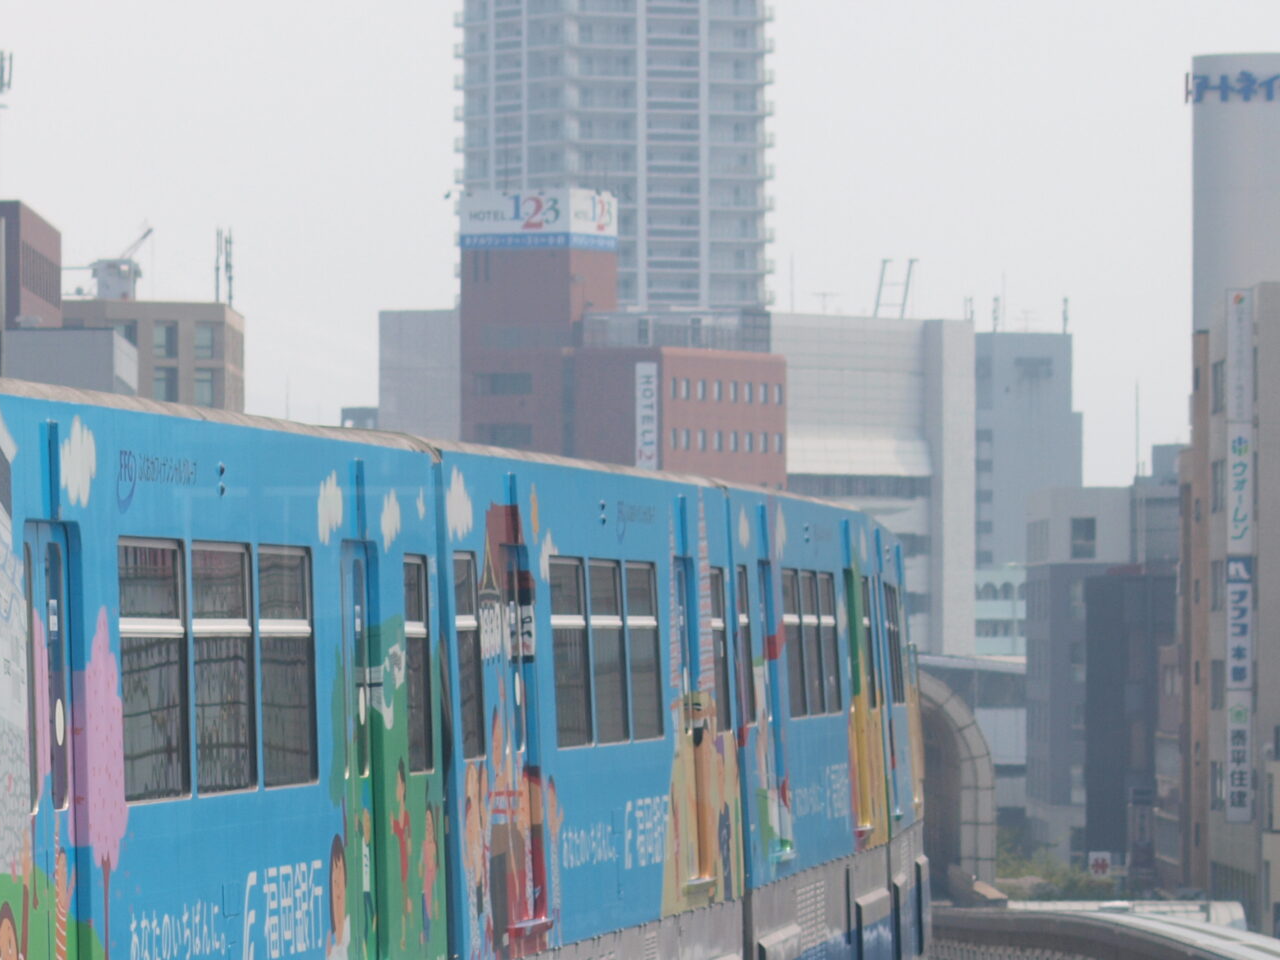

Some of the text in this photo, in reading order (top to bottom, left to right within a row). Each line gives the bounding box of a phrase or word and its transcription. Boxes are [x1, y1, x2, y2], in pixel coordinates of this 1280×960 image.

[469, 210, 507, 221] HOTEL
[641, 374, 654, 437] HOTEL
[263, 859, 323, 960] 福岡銀行
